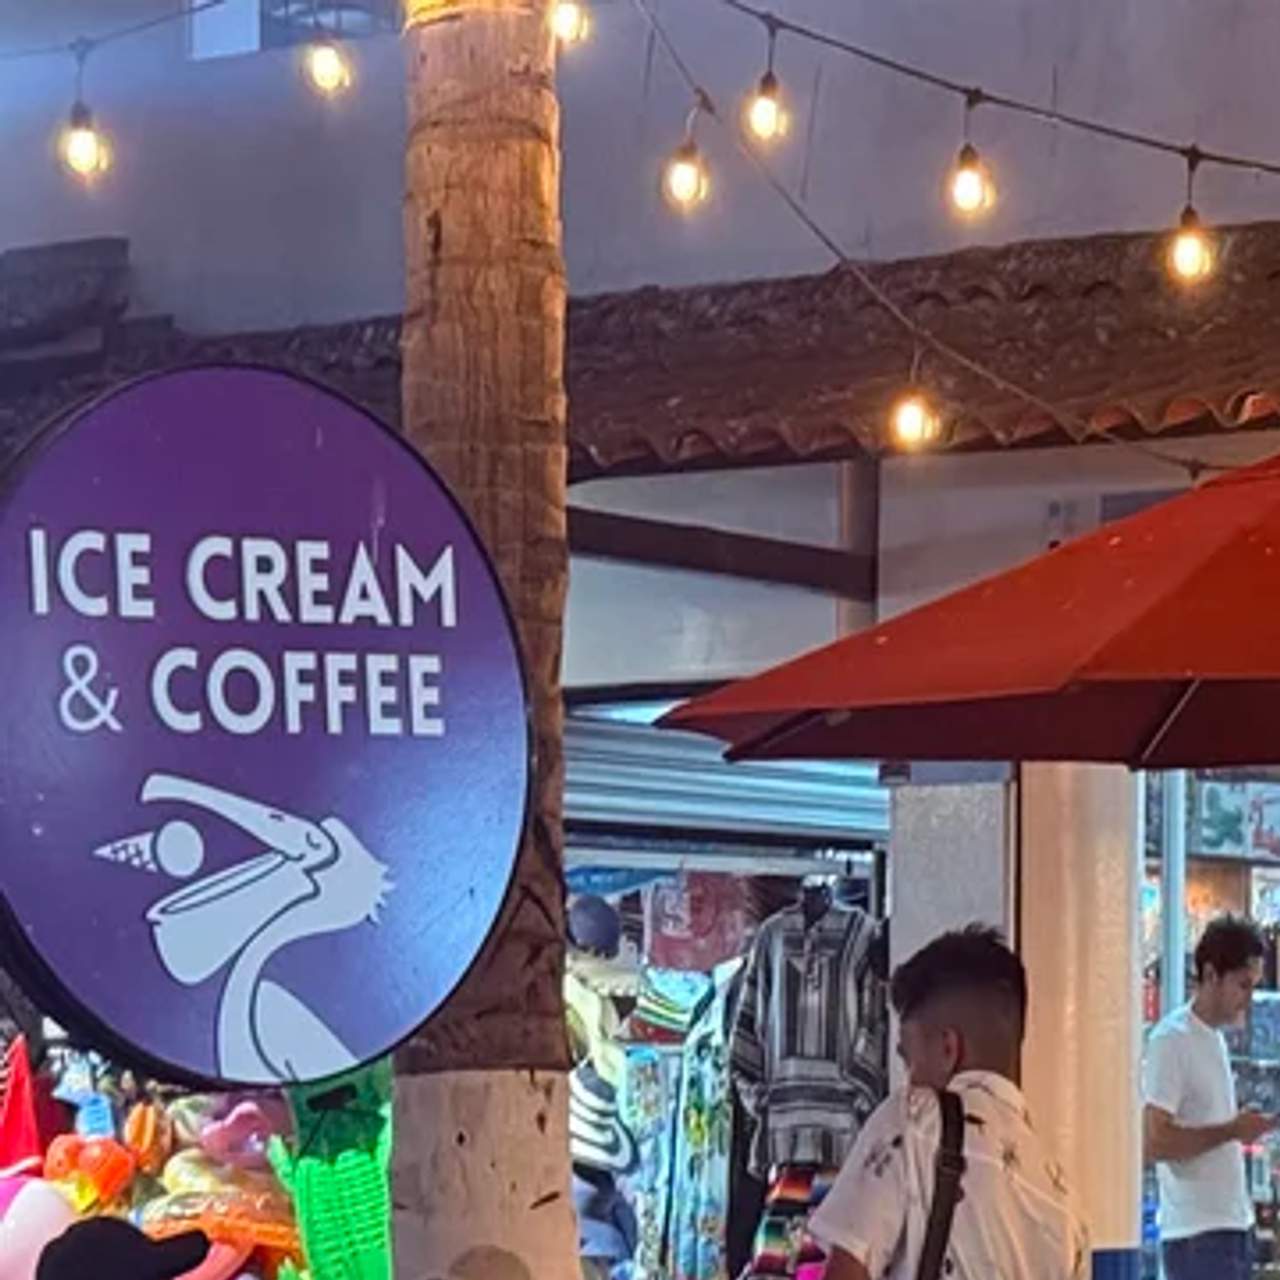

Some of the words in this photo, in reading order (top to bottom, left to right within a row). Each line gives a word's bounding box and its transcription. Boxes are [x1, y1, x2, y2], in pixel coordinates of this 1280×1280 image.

[30, 530, 154, 617] ICE
[187, 536, 457, 627] CREAM
[59, 645, 122, 731] &
[152, 648, 445, 734] COFFEE
